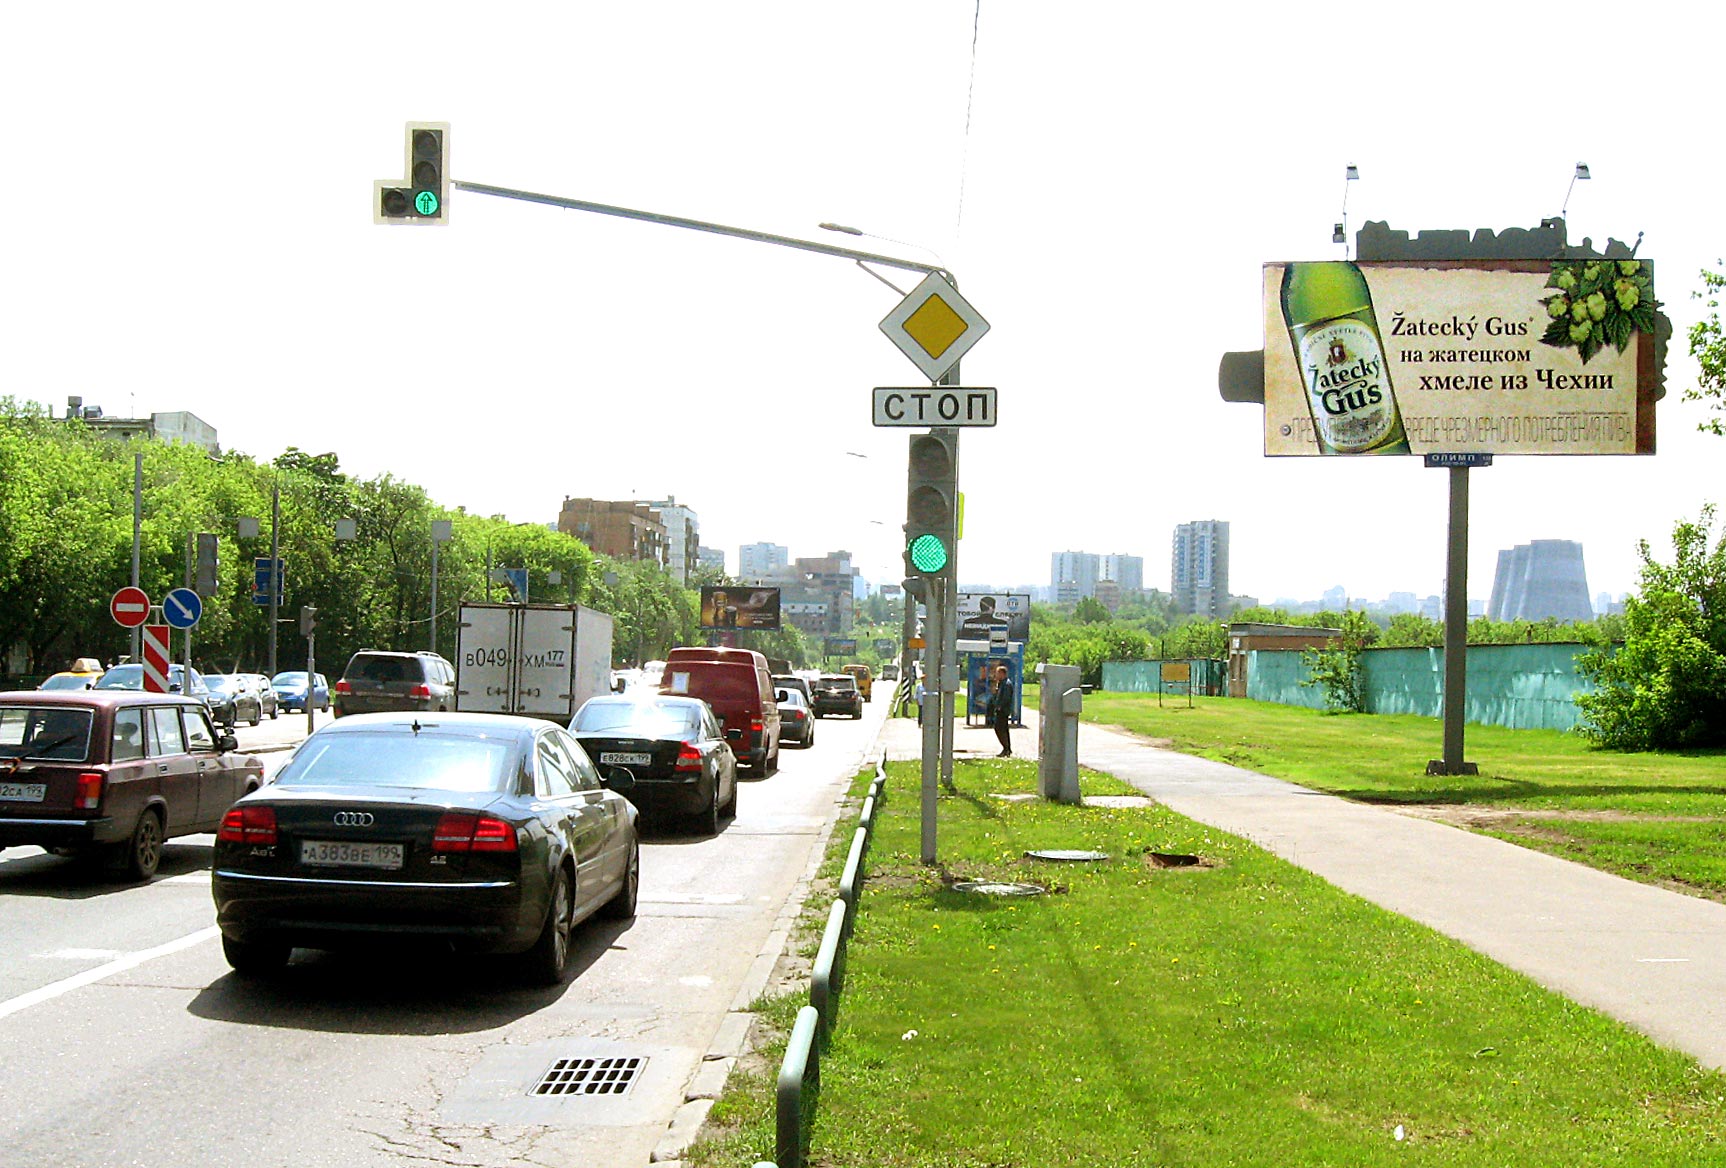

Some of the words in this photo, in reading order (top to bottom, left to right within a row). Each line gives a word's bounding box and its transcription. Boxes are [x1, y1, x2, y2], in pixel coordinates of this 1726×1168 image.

[1391, 312, 1478, 341] Žatecký
[1485, 316, 1528, 336] Gus
[1400, 349, 1423, 363] на
[1429, 349, 1531, 365] жатецком
[1308, 354, 1380, 397] Žatecký
[1419, 374, 1493, 391] хмеле
[1501, 374, 1528, 390] из
[1535, 369, 1614, 390] Чехии
[884, 393, 988, 420] СТОП
[1321, 381, 1383, 415] Gus
[1431, 454, 1475, 462] ОЛИМП
[465, 648, 507, 667] В049
[547, 650, 564, 661] 177
